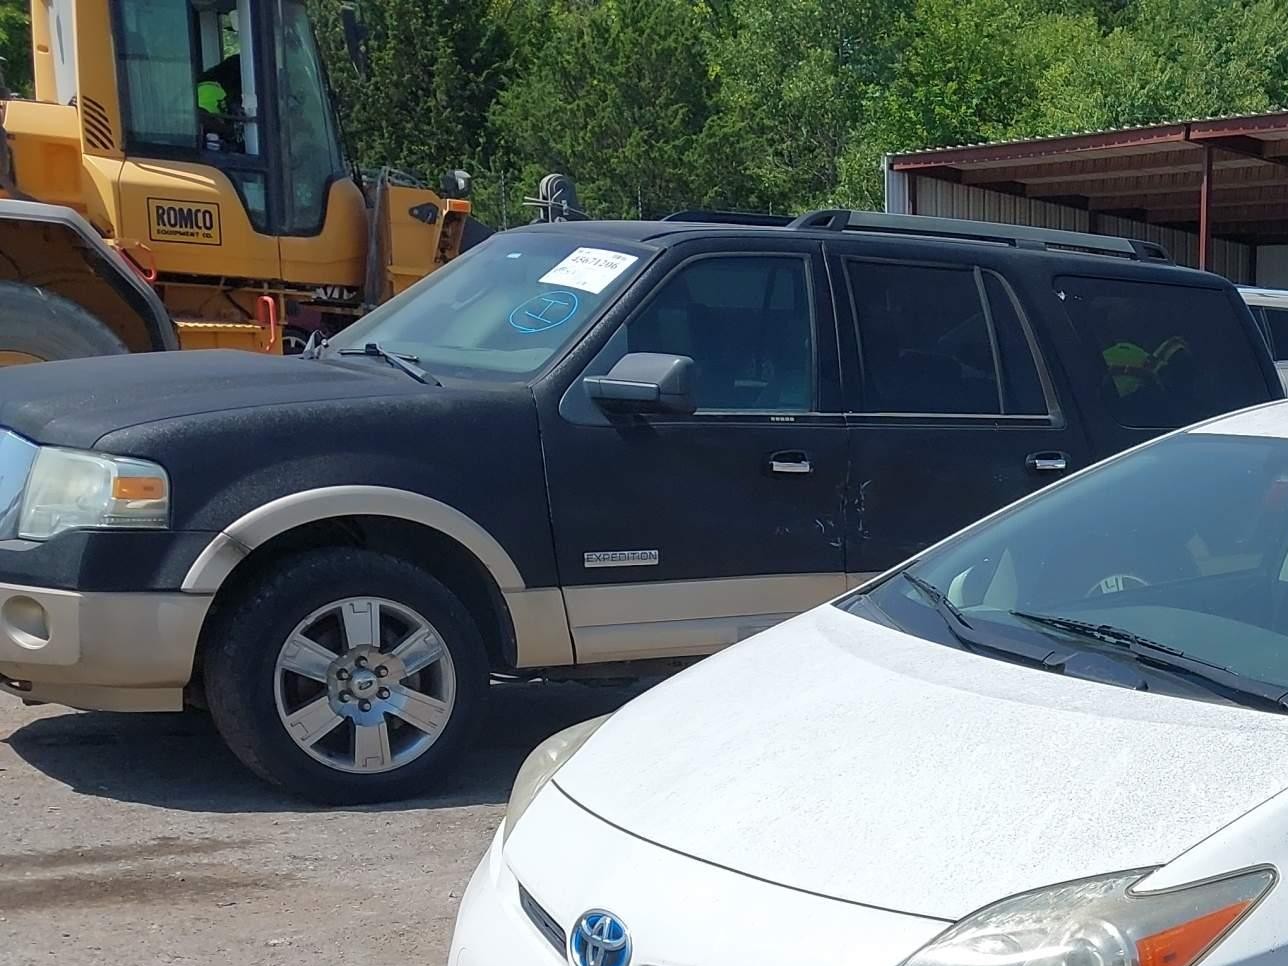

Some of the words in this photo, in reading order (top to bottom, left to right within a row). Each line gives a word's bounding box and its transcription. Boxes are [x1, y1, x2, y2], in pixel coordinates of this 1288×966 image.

[156, 205, 213, 230] ROMCO
[157, 229, 199, 238] EQUIPMENT
[586, 551, 658, 562] EXPEDITION
